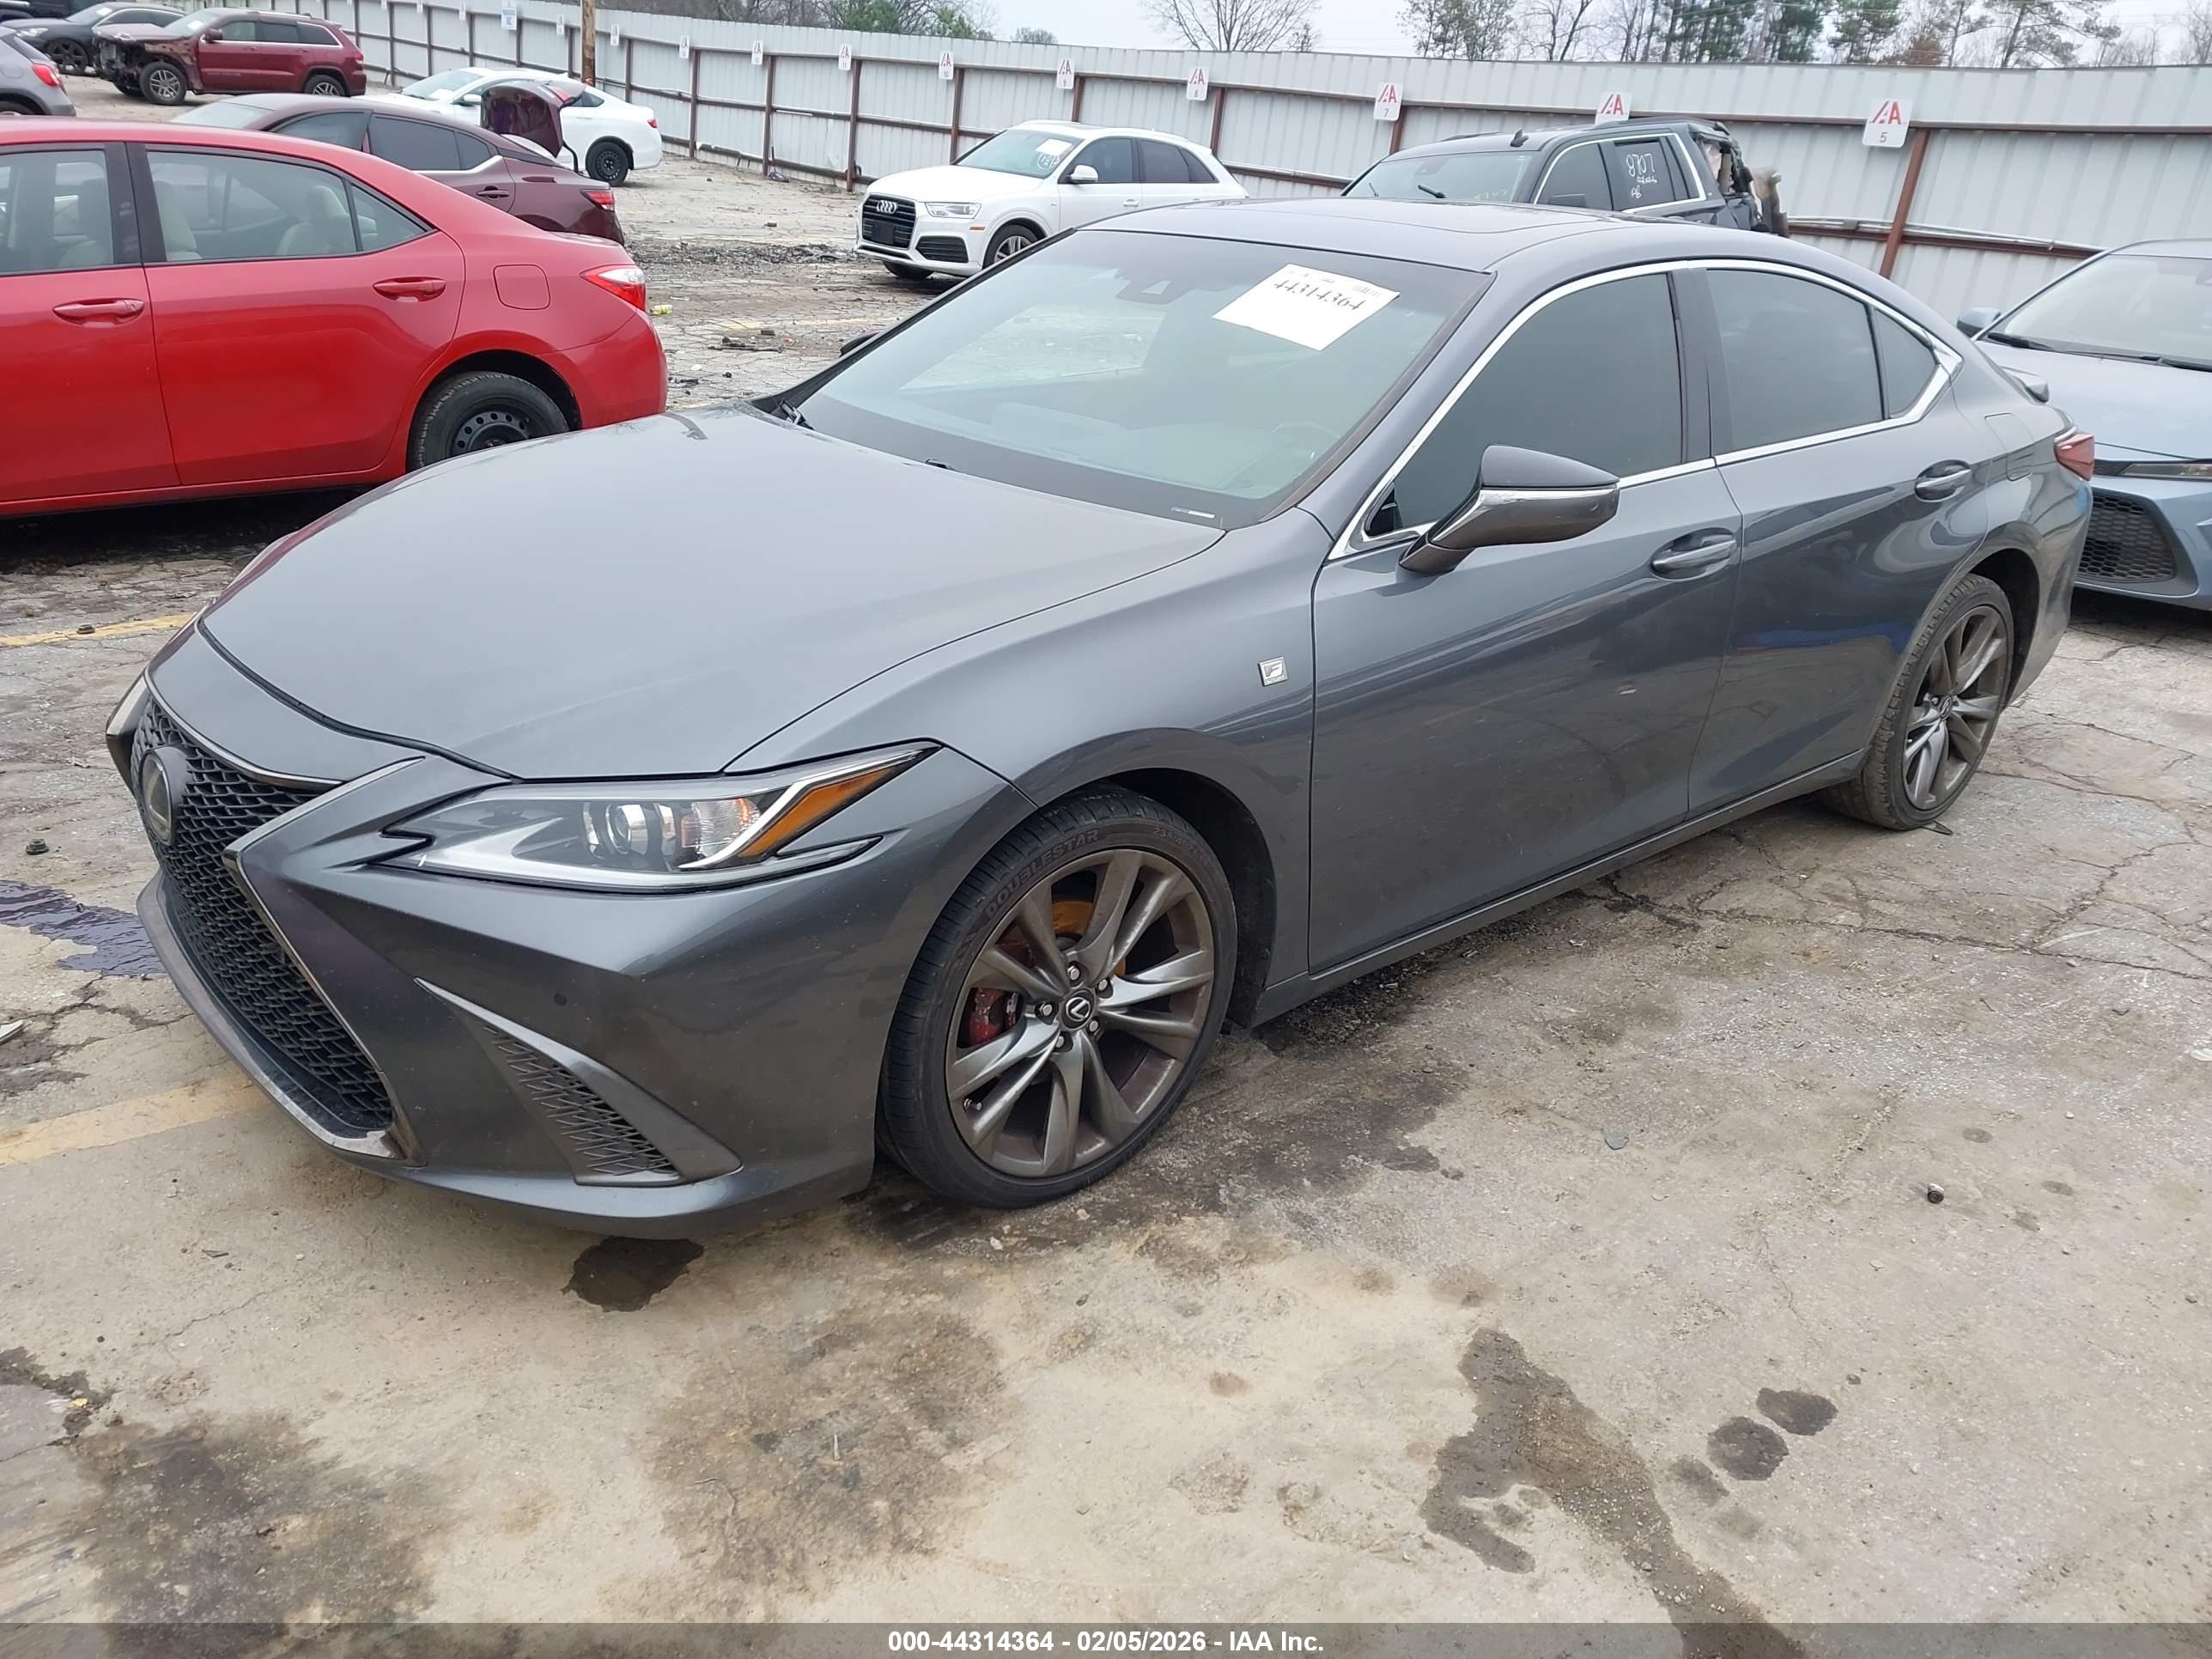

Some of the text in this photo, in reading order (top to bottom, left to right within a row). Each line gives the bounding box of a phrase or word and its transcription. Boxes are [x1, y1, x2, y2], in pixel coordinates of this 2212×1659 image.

[1879, 131, 1889, 143] 5
[1626, 153, 1655, 178] 8707
[1273, 279, 1366, 310] 44314364
[986, 828, 1099, 917] DOUBLESTAR
